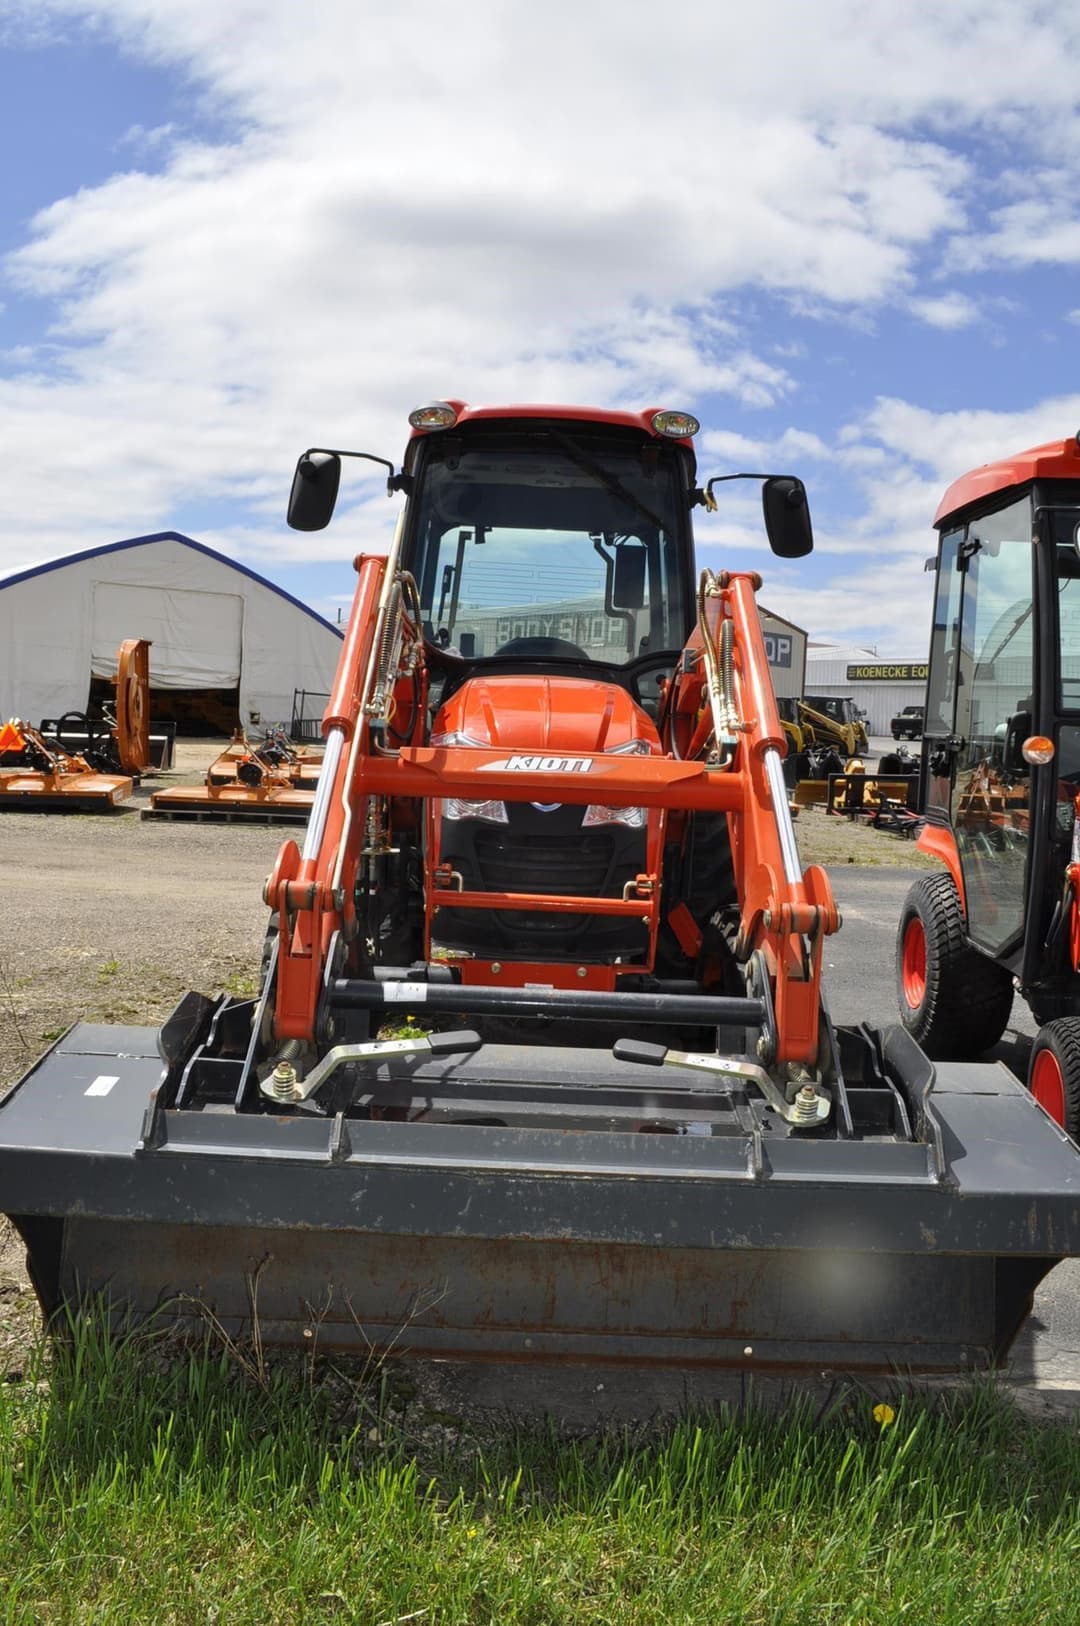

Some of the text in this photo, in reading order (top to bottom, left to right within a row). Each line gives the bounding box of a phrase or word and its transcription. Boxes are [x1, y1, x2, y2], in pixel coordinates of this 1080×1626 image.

[498, 619, 553, 641] BODY
[764, 637, 790, 662] OP
[856, 666, 908, 677] KOENECKE
[505, 756, 593, 772] KIOTI
